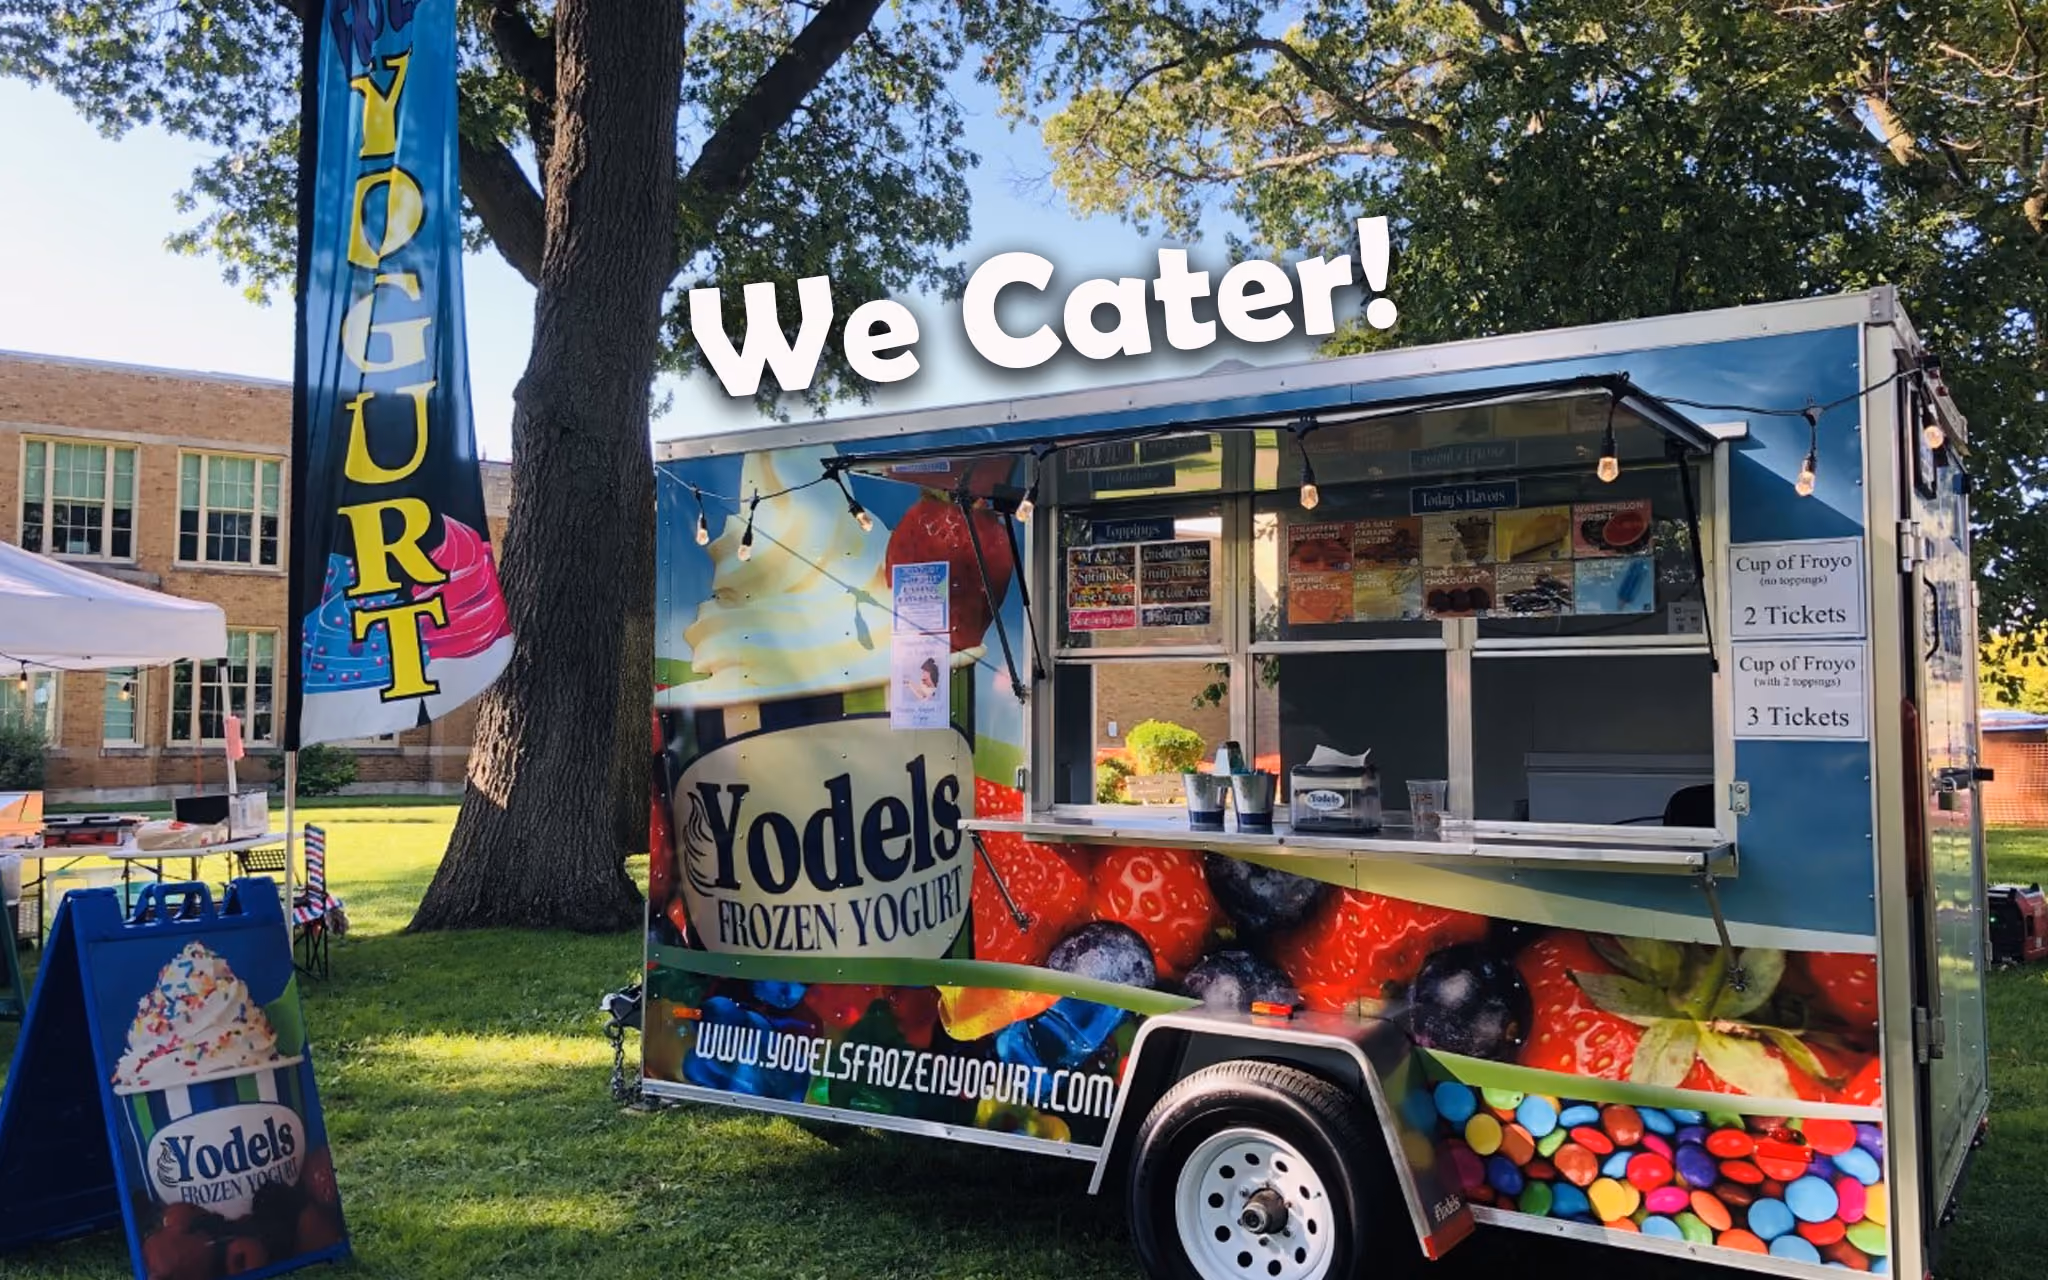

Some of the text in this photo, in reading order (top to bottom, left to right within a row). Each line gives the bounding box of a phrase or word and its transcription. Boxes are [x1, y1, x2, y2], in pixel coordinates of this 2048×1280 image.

[337, 44, 450, 703] YOGURT
[1423, 487, 1505, 508] Today's Flavors
[1105, 523, 1161, 540] Toppings
[1736, 554, 1853, 575] Cup of Froyo
[1078, 569, 1130, 585] Sprinkles
[1424, 575, 1480, 585] CHOCOLATE
[1759, 575, 1828, 587] (no toppings)
[1744, 605, 1847, 626] 2 Tickets
[1739, 655, 1856, 675] Cup of Froyo
[1754, 676, 1841, 688] (with 2 toppings)
[1747, 706, 1850, 726] 3 Tickets
[696, 754, 963, 895] Yodels
[718, 865, 963, 952] FROZEN YOGURT
[694, 1021, 1115, 1119] WWW.YODELSFROZENYOGURT.COM
[164, 1116, 296, 1183] Yodels
[180, 1178, 243, 1205] FROZEN
